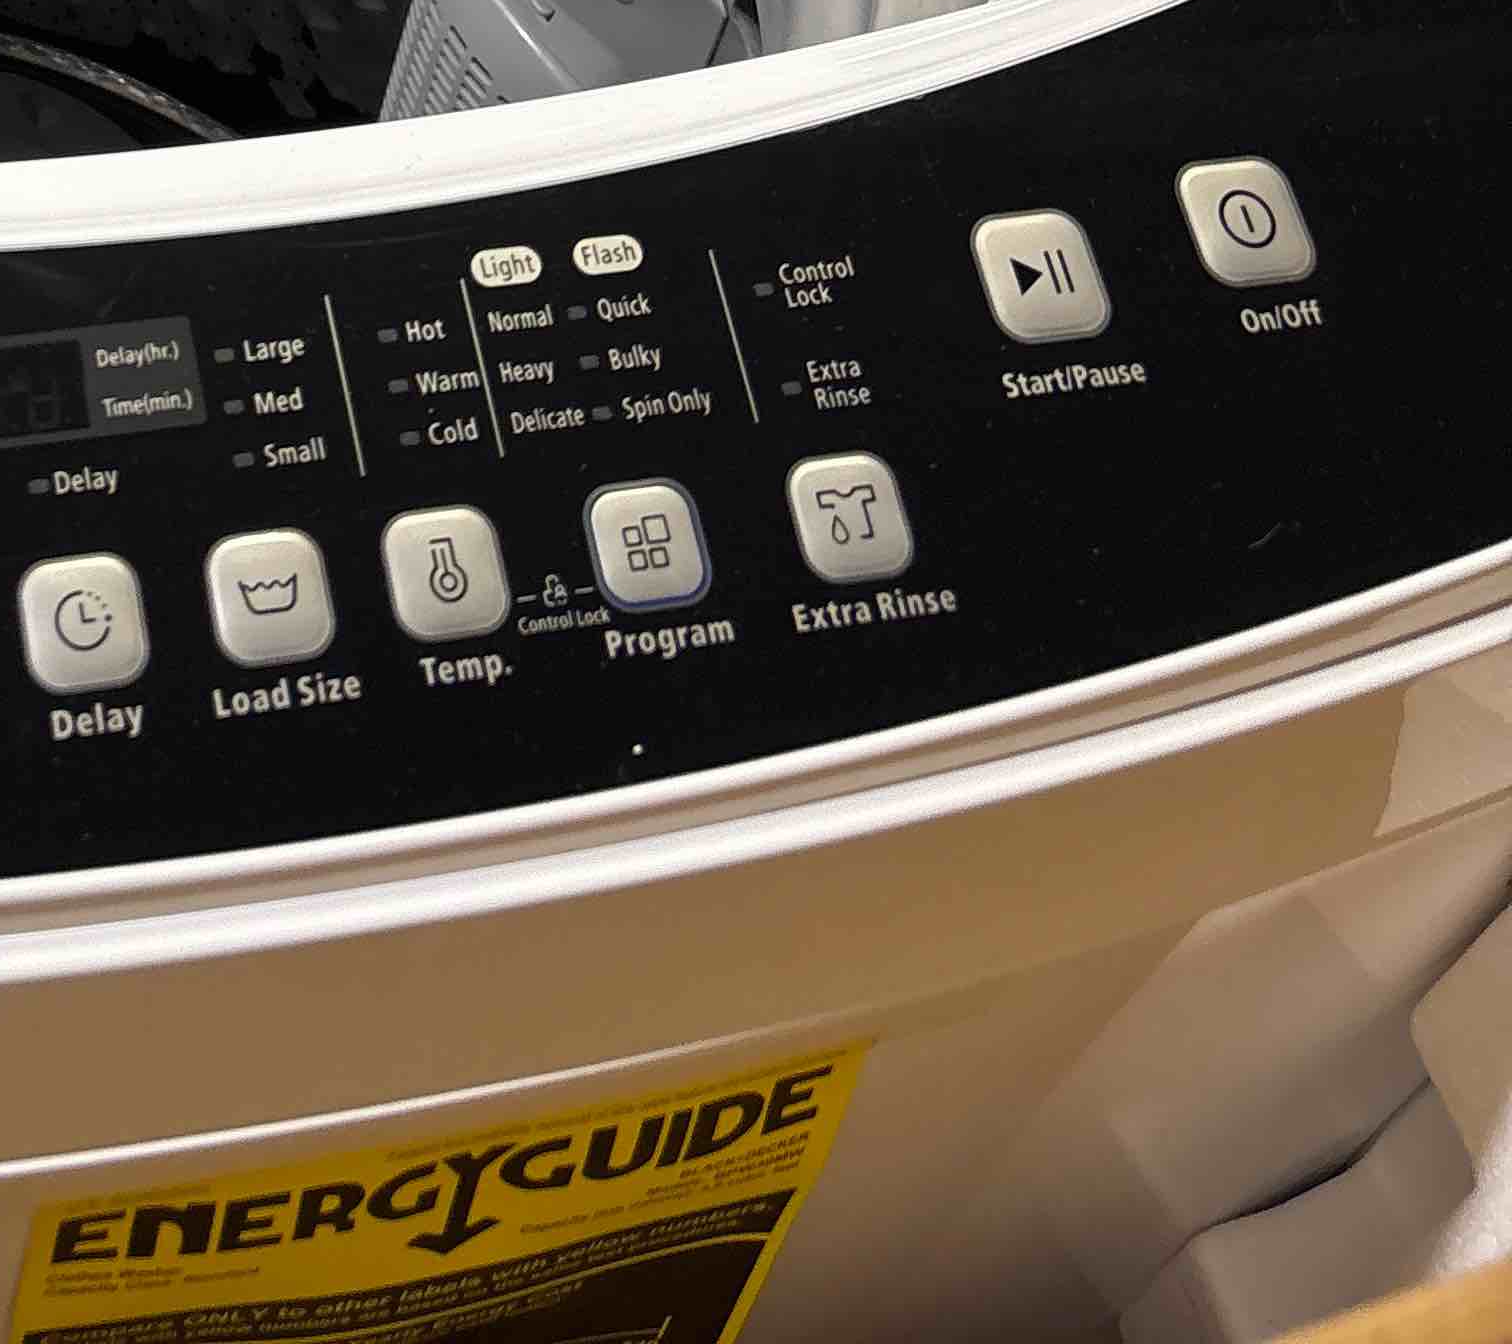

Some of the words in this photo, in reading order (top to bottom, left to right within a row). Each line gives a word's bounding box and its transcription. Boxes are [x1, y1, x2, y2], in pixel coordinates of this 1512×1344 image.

[479, 253, 536, 282] Light
[580, 240, 637, 267] Flash
[778, 255, 855, 285] Control
[596, 292, 652, 323] Quick
[784, 281, 833, 308] Lock
[405, 319, 447, 342] Hot
[487, 303, 554, 333] Normal
[1240, 299, 1322, 333] On/Off
[95, 340, 180, 368] Delay(hr.)
[243, 338, 305, 364] Large
[607, 343, 661, 372] Bulky
[415, 371, 481, 396] Warm
[498, 361, 554, 385] Heavy
[806, 359, 862, 383] Extra
[1001, 363, 1147, 399] Start/Pause
[101, 388, 193, 417] Time(min.)
[253, 386, 304, 414] Med
[621, 394, 665, 424] Spin
[667, 387, 711, 416] Only
[813, 385, 871, 410] Rinse
[428, 416, 479, 445] Cold
[510, 407, 585, 434] Delicate
[263, 436, 326, 468] Small
[53, 466, 118, 495] Delay
[517, 609, 575, 636] Control
[575, 605, 611, 627] Lock
[791, 600, 872, 633] Extra
[875, 588, 956, 620] Rinse
[604, 620, 735, 659] Program
[418, 654, 513, 686] Temp.
[212, 677, 291, 718] Load
[296, 672, 361, 706] Size
[50, 702, 143, 741] Delay
[50, 1063, 834, 1265] ENERGYGUIDE
